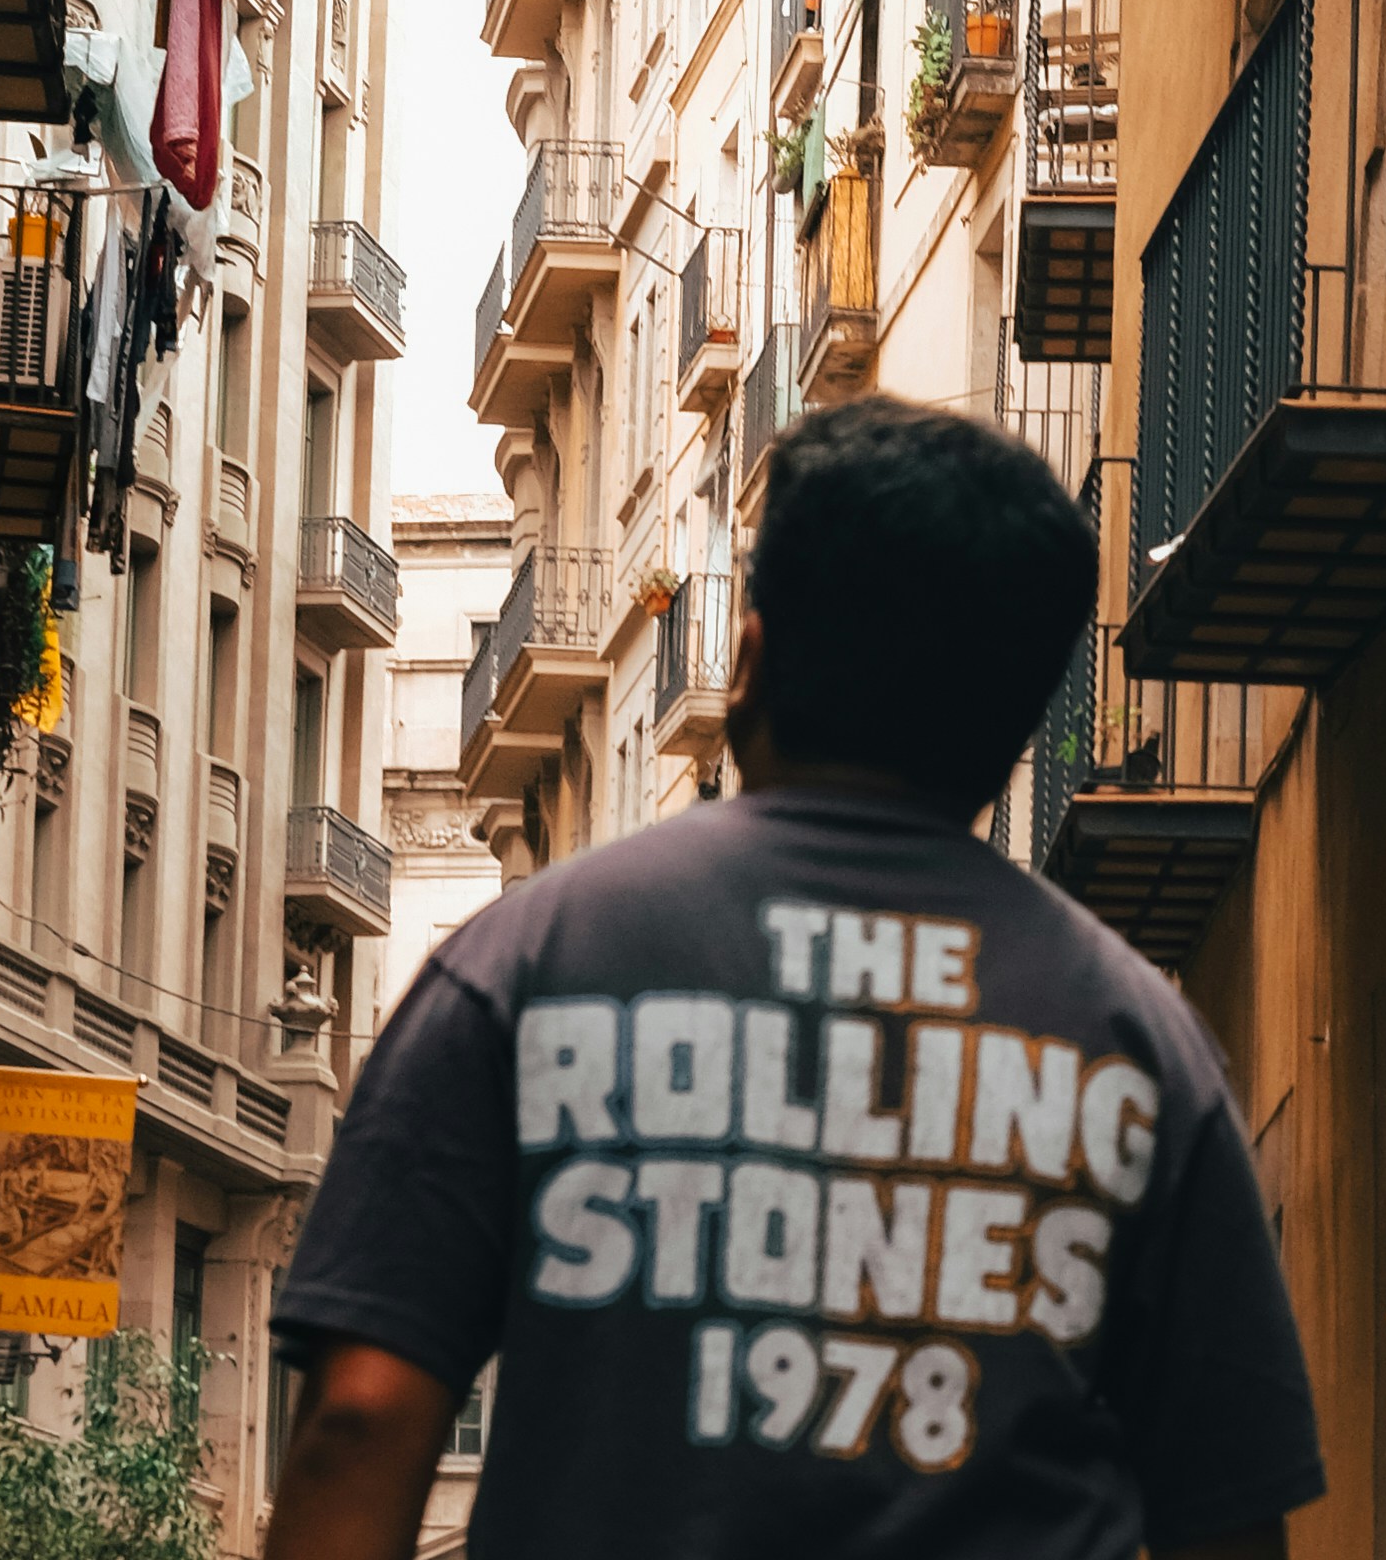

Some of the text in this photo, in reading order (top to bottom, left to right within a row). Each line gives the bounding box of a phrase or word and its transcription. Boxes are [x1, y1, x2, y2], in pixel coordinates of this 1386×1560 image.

[763, 898, 977, 1014] THE
[60, 1090, 86, 1104] DE
[101, 1093, 126, 1109] PA
[515, 992, 1159, 1208] ROLLING
[528, 1152, 1115, 1346] STONES
[691, 1320, 975, 1470] 1978
